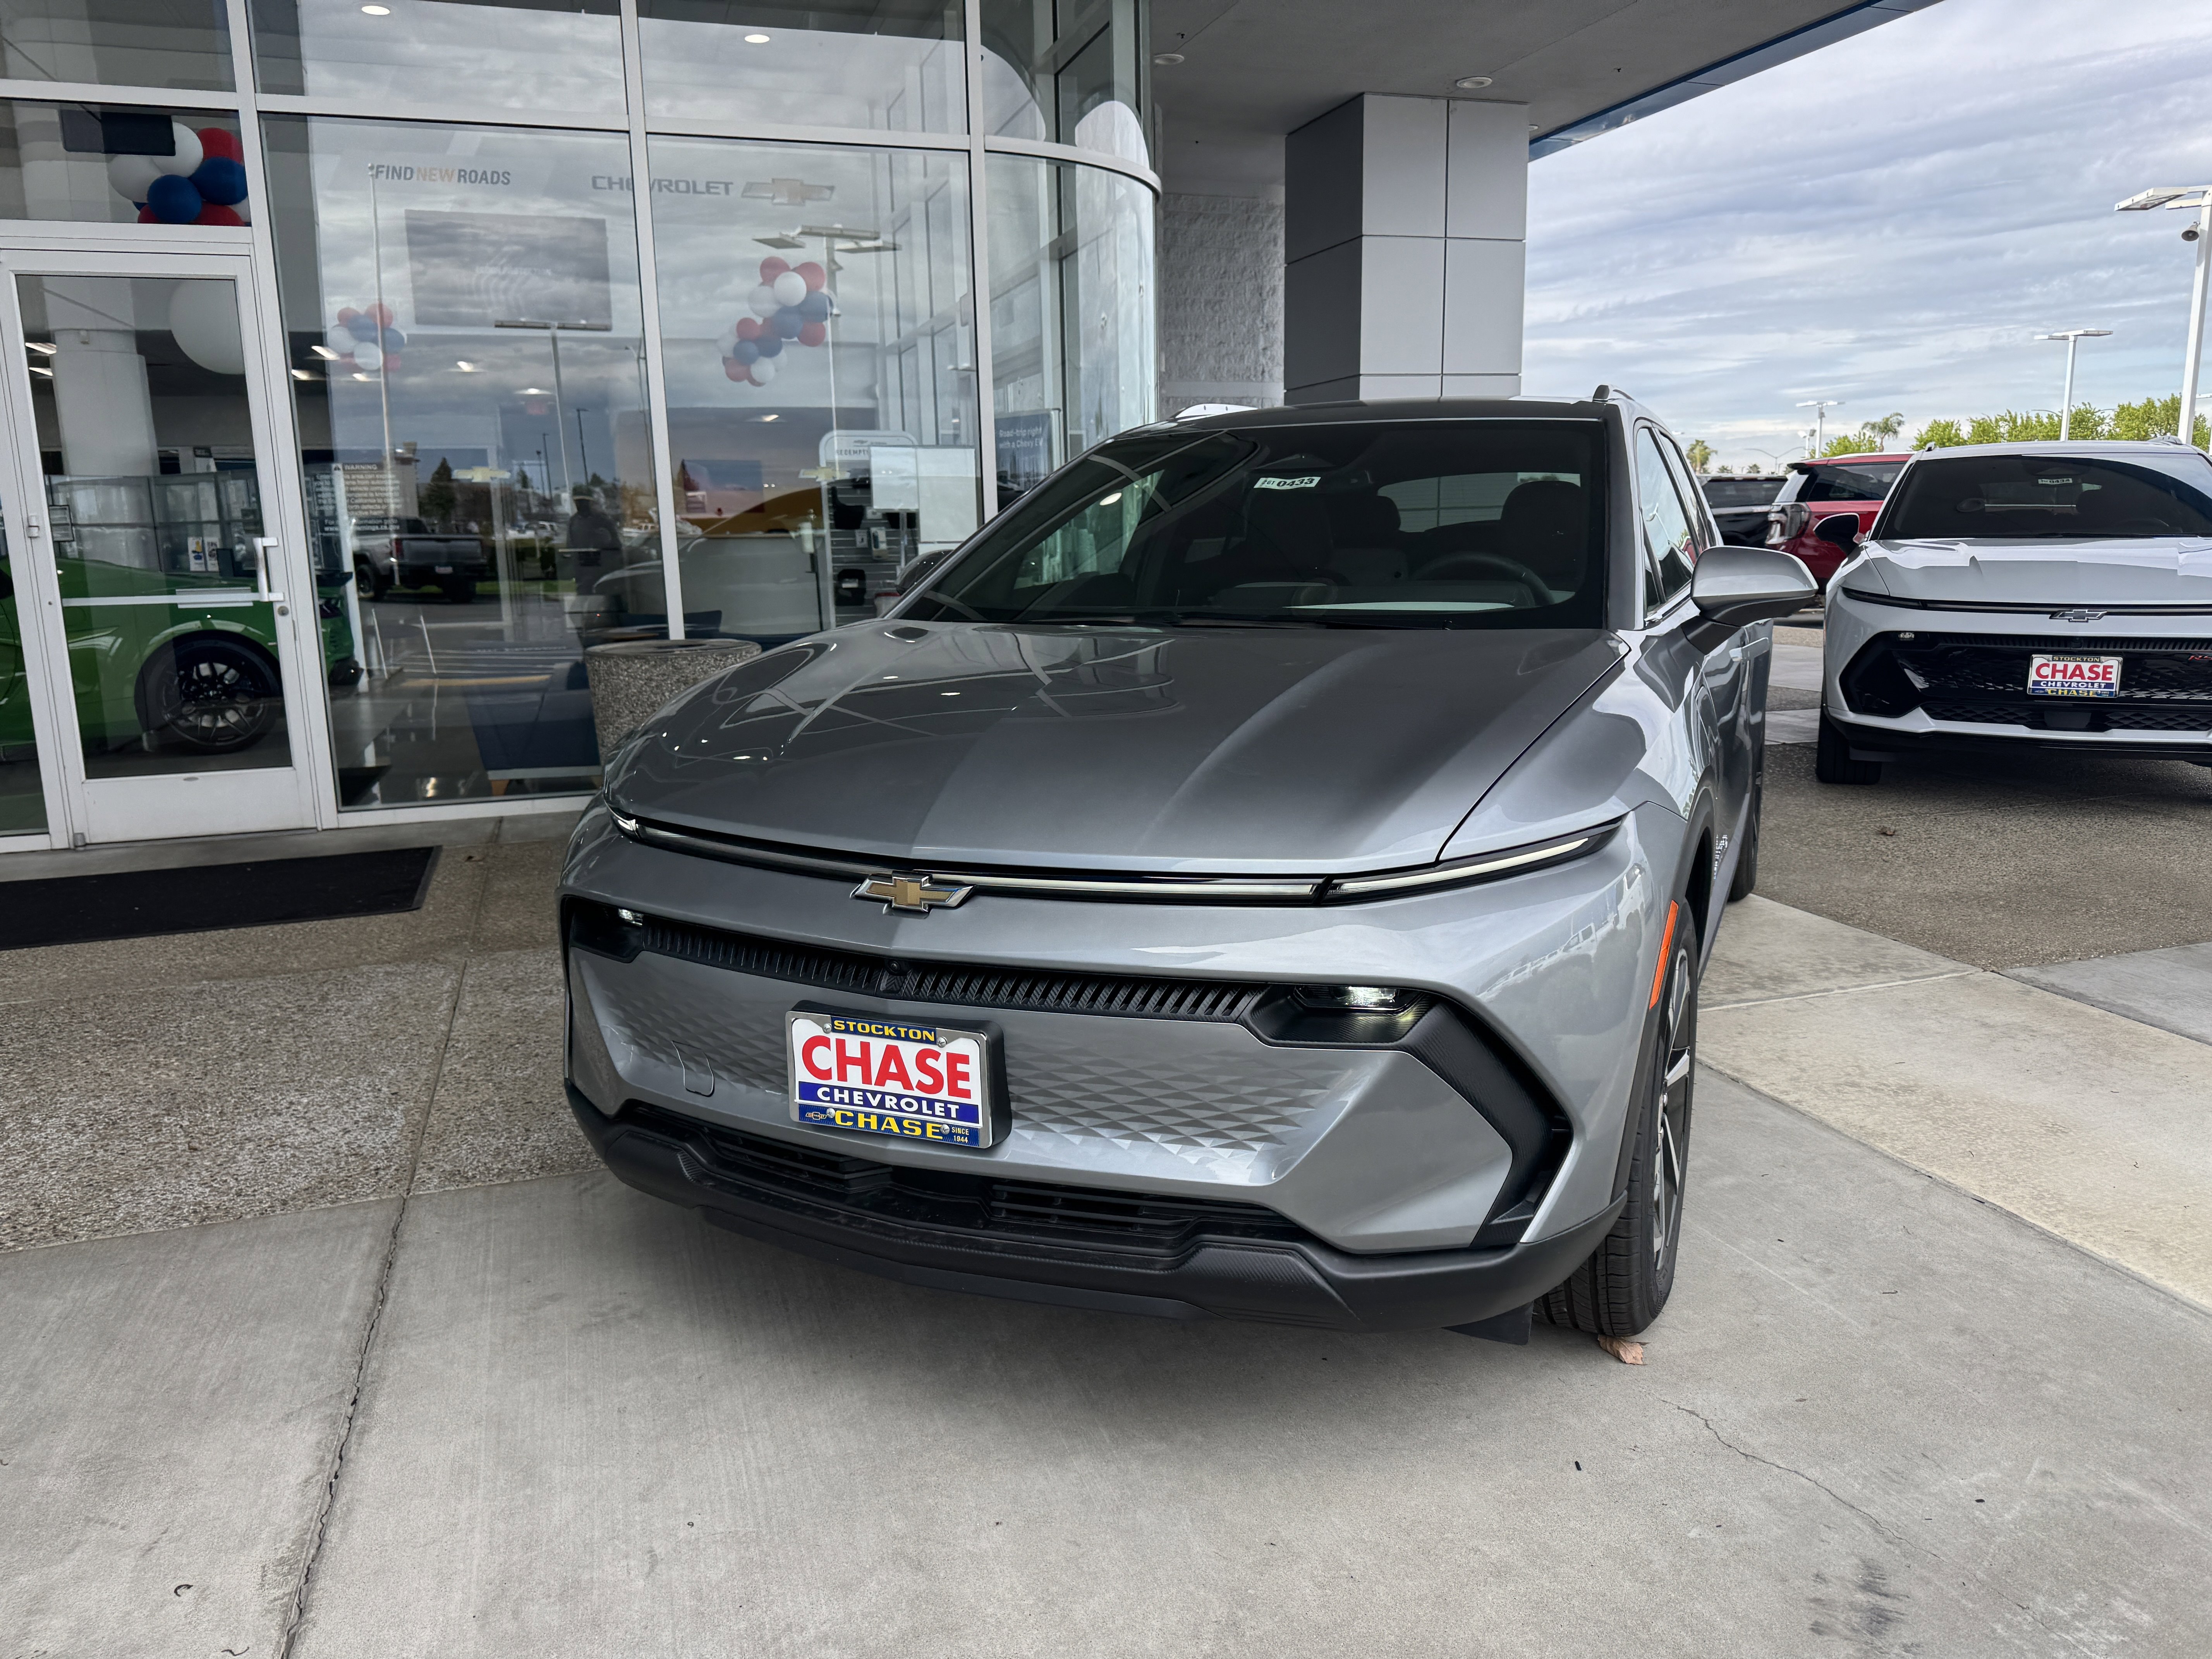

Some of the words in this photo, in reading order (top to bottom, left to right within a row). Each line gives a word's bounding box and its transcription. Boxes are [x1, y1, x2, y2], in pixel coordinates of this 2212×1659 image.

[375, 165, 414, 180] FIND
[416, 167, 456, 182] NEW
[457, 169, 511, 185] ROADS
[1276, 478, 1315, 487] 0433
[2035, 663, 2114, 681] CHASE
[2047, 688, 2097, 697] CHASE
[833, 1020, 935, 1042] STOCKTON
[802, 1035, 971, 1099] CHASE
[817, 1087, 960, 1118] CHEVROLET
[835, 1110, 943, 1140] CHASE
[951, 1126, 969, 1135] SINCE
[953, 1135, 968, 1144] 1944
